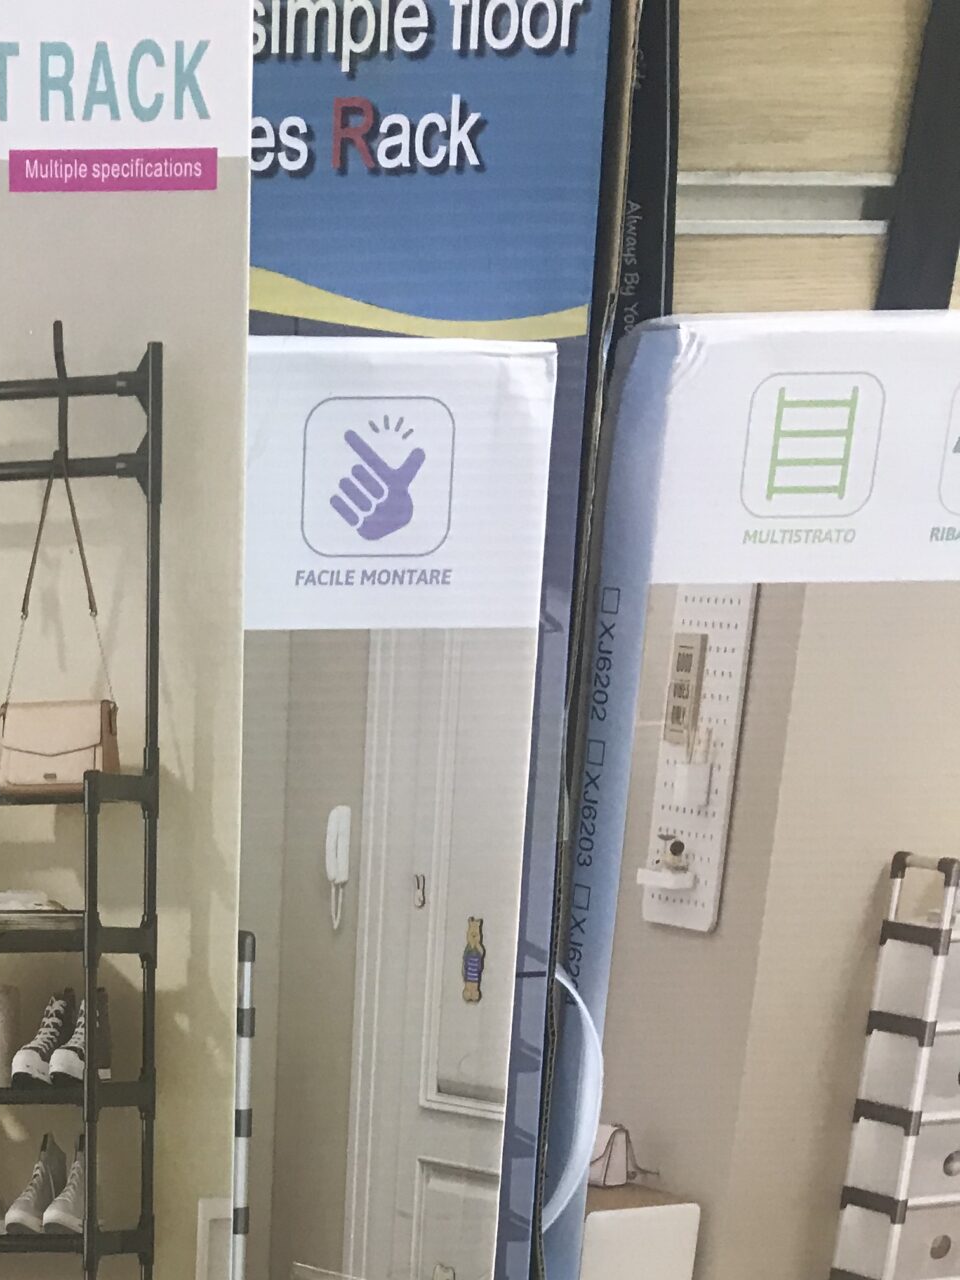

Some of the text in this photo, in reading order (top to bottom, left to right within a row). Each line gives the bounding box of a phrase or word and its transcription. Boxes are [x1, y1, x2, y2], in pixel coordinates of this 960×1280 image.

[252, 0, 582, 73] simple floor
[40, 39, 211, 122] RACK
[332, 94, 481, 169] Rack
[25, 158, 202, 182] Multiple specifications
[622, 200, 642, 266] Always
[620, 272, 640, 297] By
[742, 528, 856, 545] MULTISTRATO
[294, 568, 453, 587] FACILE MONTARE
[590, 621, 616, 722] XJ6202
[577, 770, 601, 868] XJ6203
